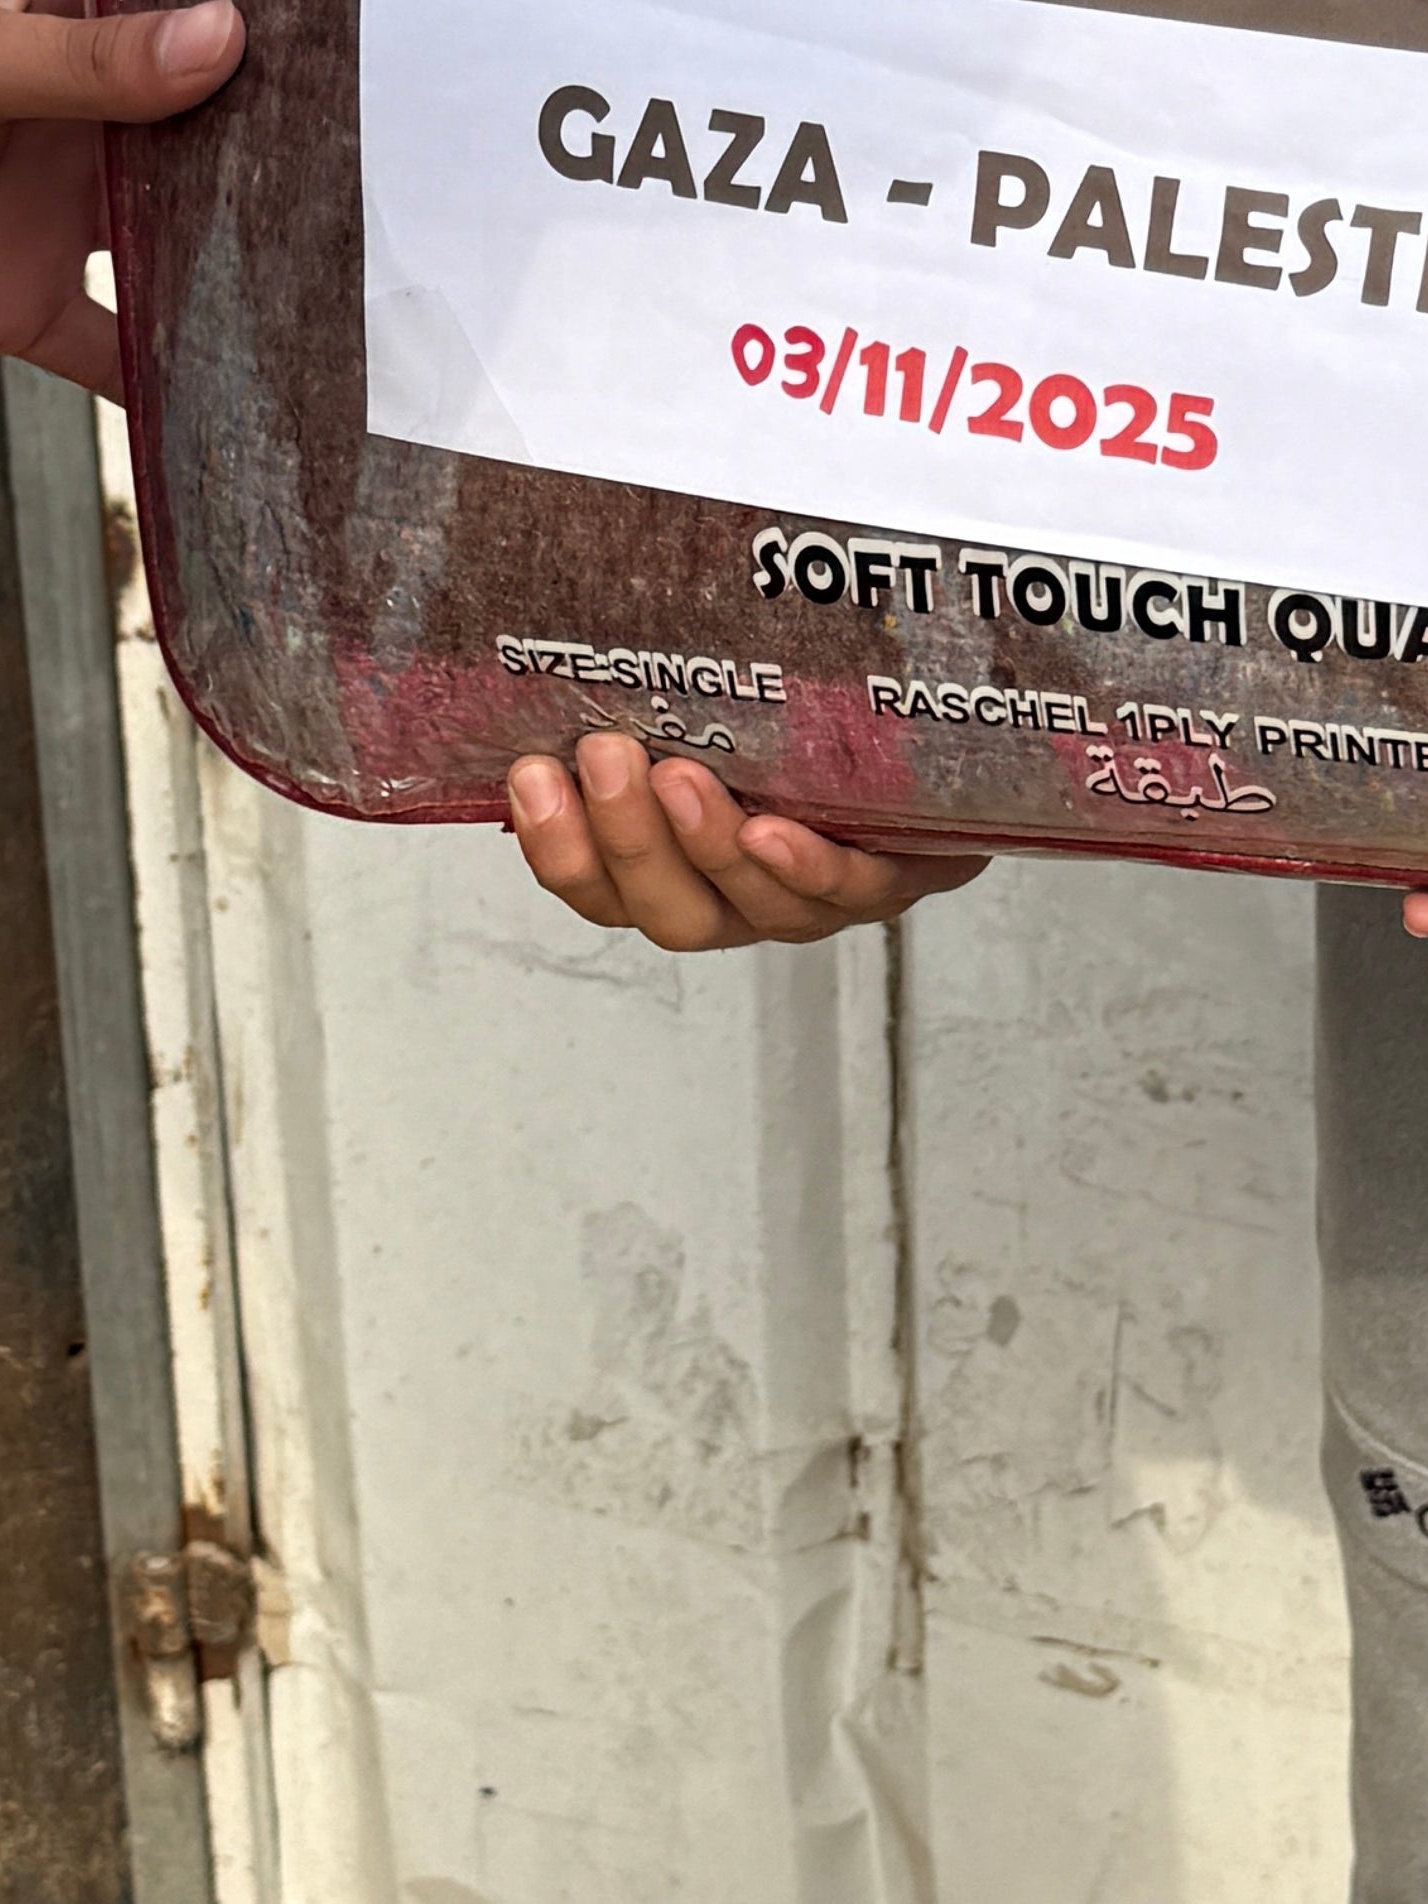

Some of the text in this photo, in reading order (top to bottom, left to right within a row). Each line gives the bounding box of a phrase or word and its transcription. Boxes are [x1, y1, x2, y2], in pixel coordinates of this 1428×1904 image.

[537, 84, 849, 224] GAZA
[885, 178, 934, 207] -
[730, 322, 1220, 471] 03/11/2025
[751, 528, 942, 614] SOFT
[958, 548, 1247, 647] TOUCH
[866, 675, 1109, 737] RASCHEL
[1115, 701, 1240, 749] 1PLY
[1085, 744, 1277, 822] طبقة
